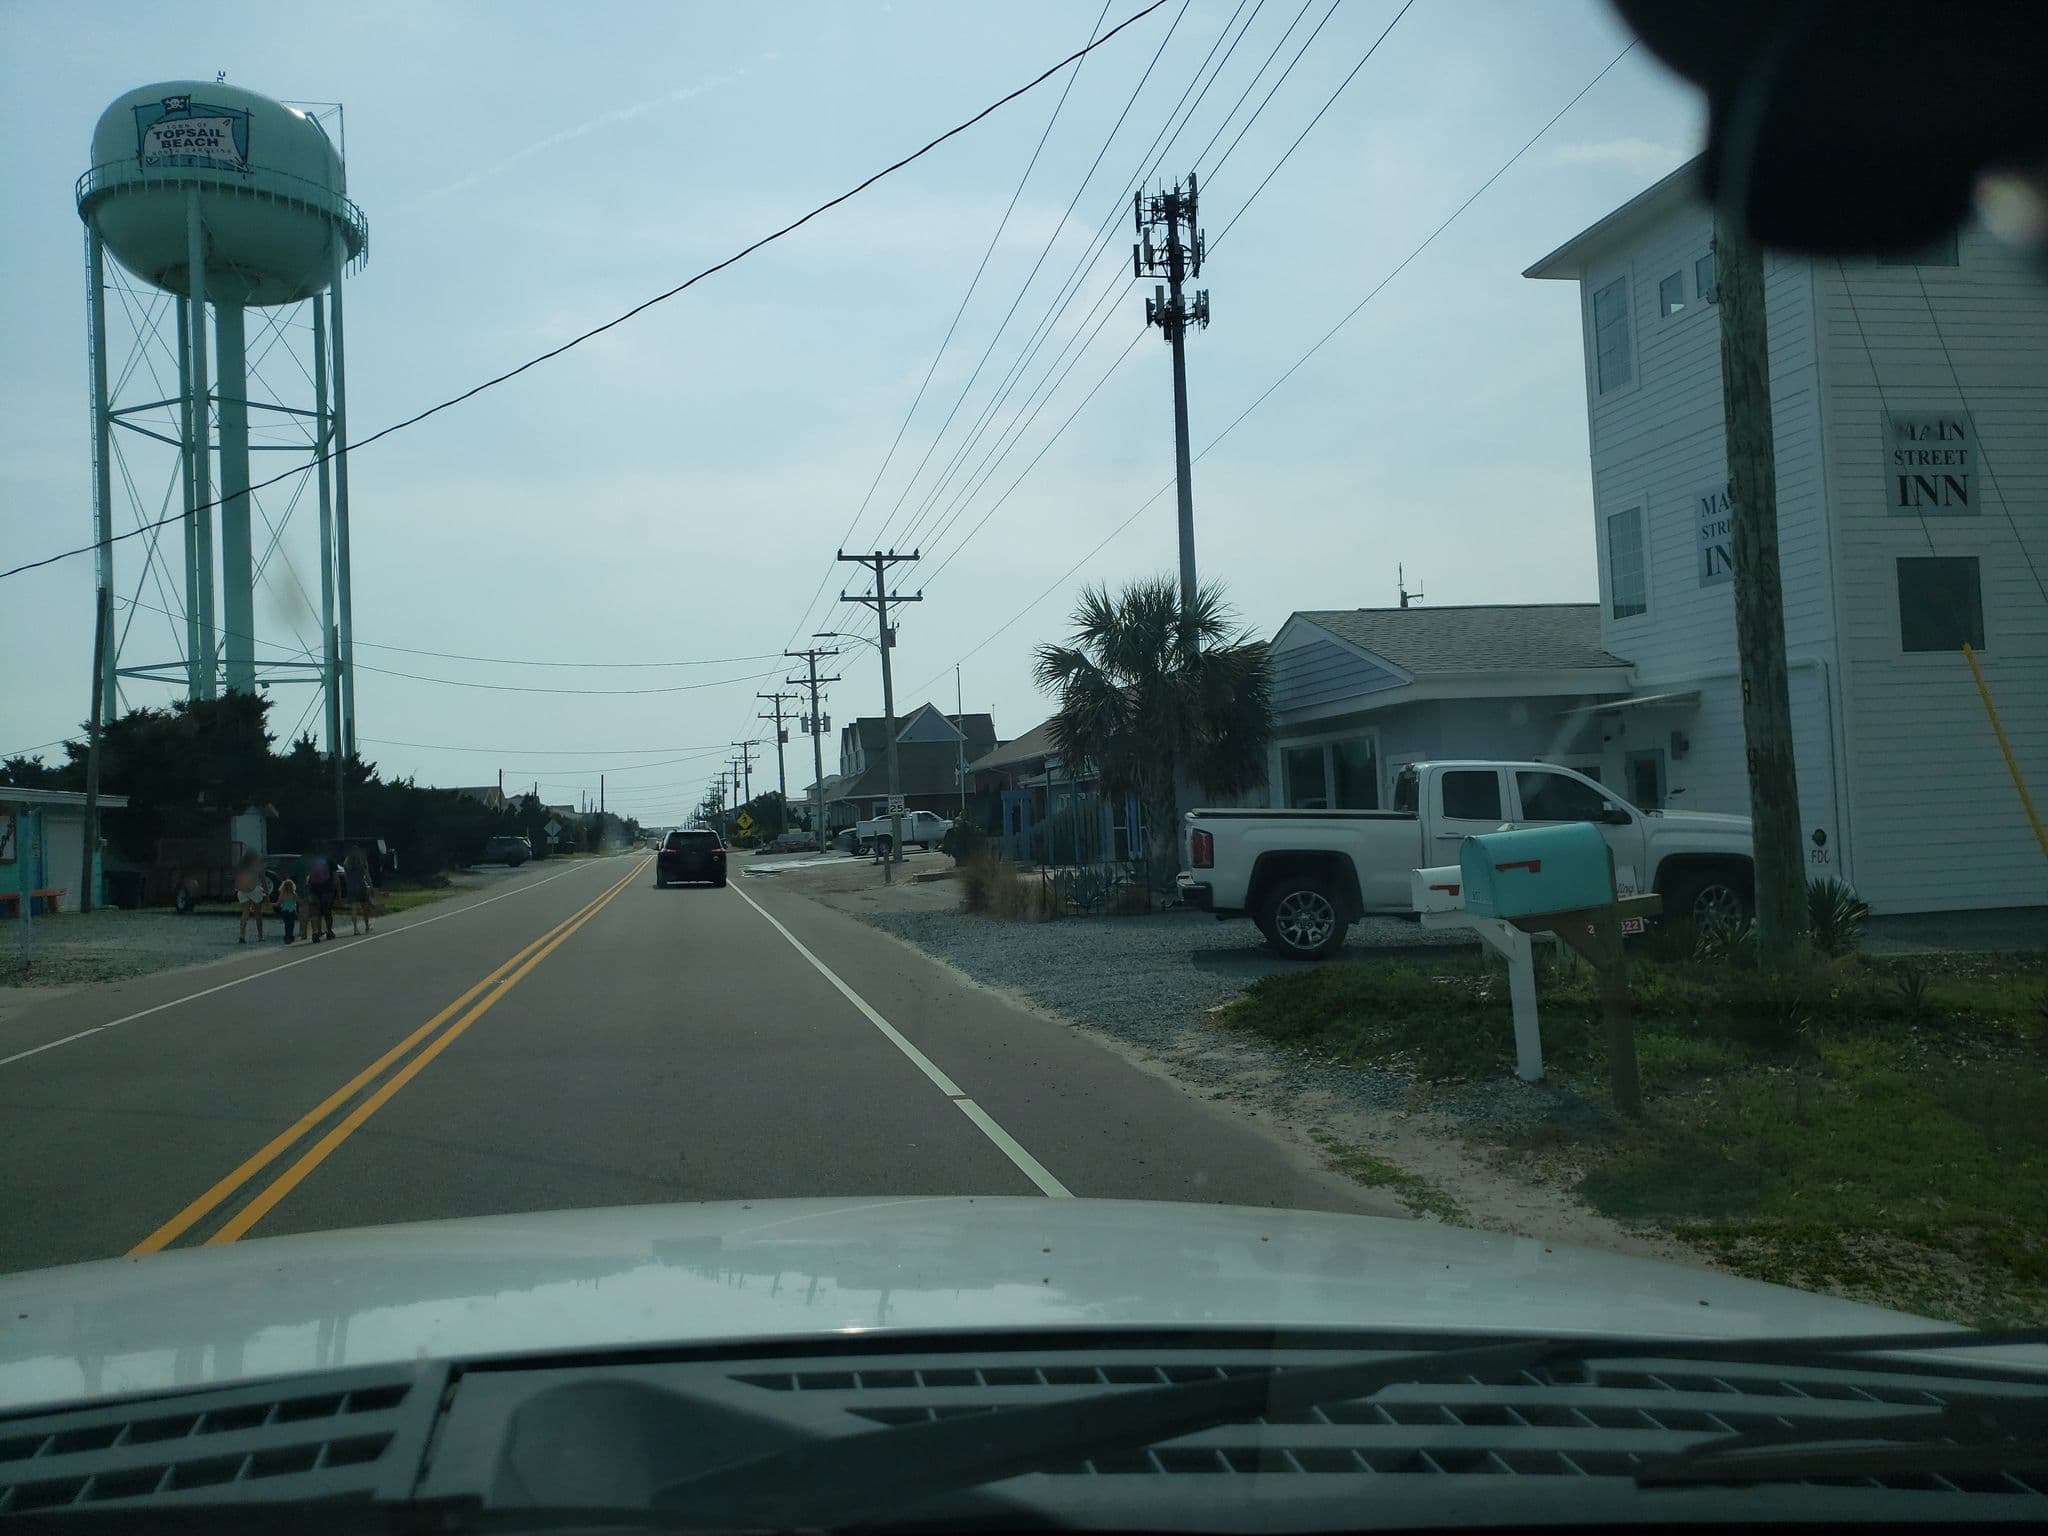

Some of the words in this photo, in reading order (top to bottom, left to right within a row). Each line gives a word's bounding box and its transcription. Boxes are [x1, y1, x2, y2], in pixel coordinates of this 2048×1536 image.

[154, 128, 225, 140] TOPSAIL
[161, 138, 219, 149] BEACH
[1894, 449, 1968, 466] STREET
[1896, 474, 1969, 507] INN
[1701, 492, 1729, 518] MA
[1702, 519, 1731, 541] STR
[1704, 543, 1733, 577] IN
[890, 804, 904, 813] 25
